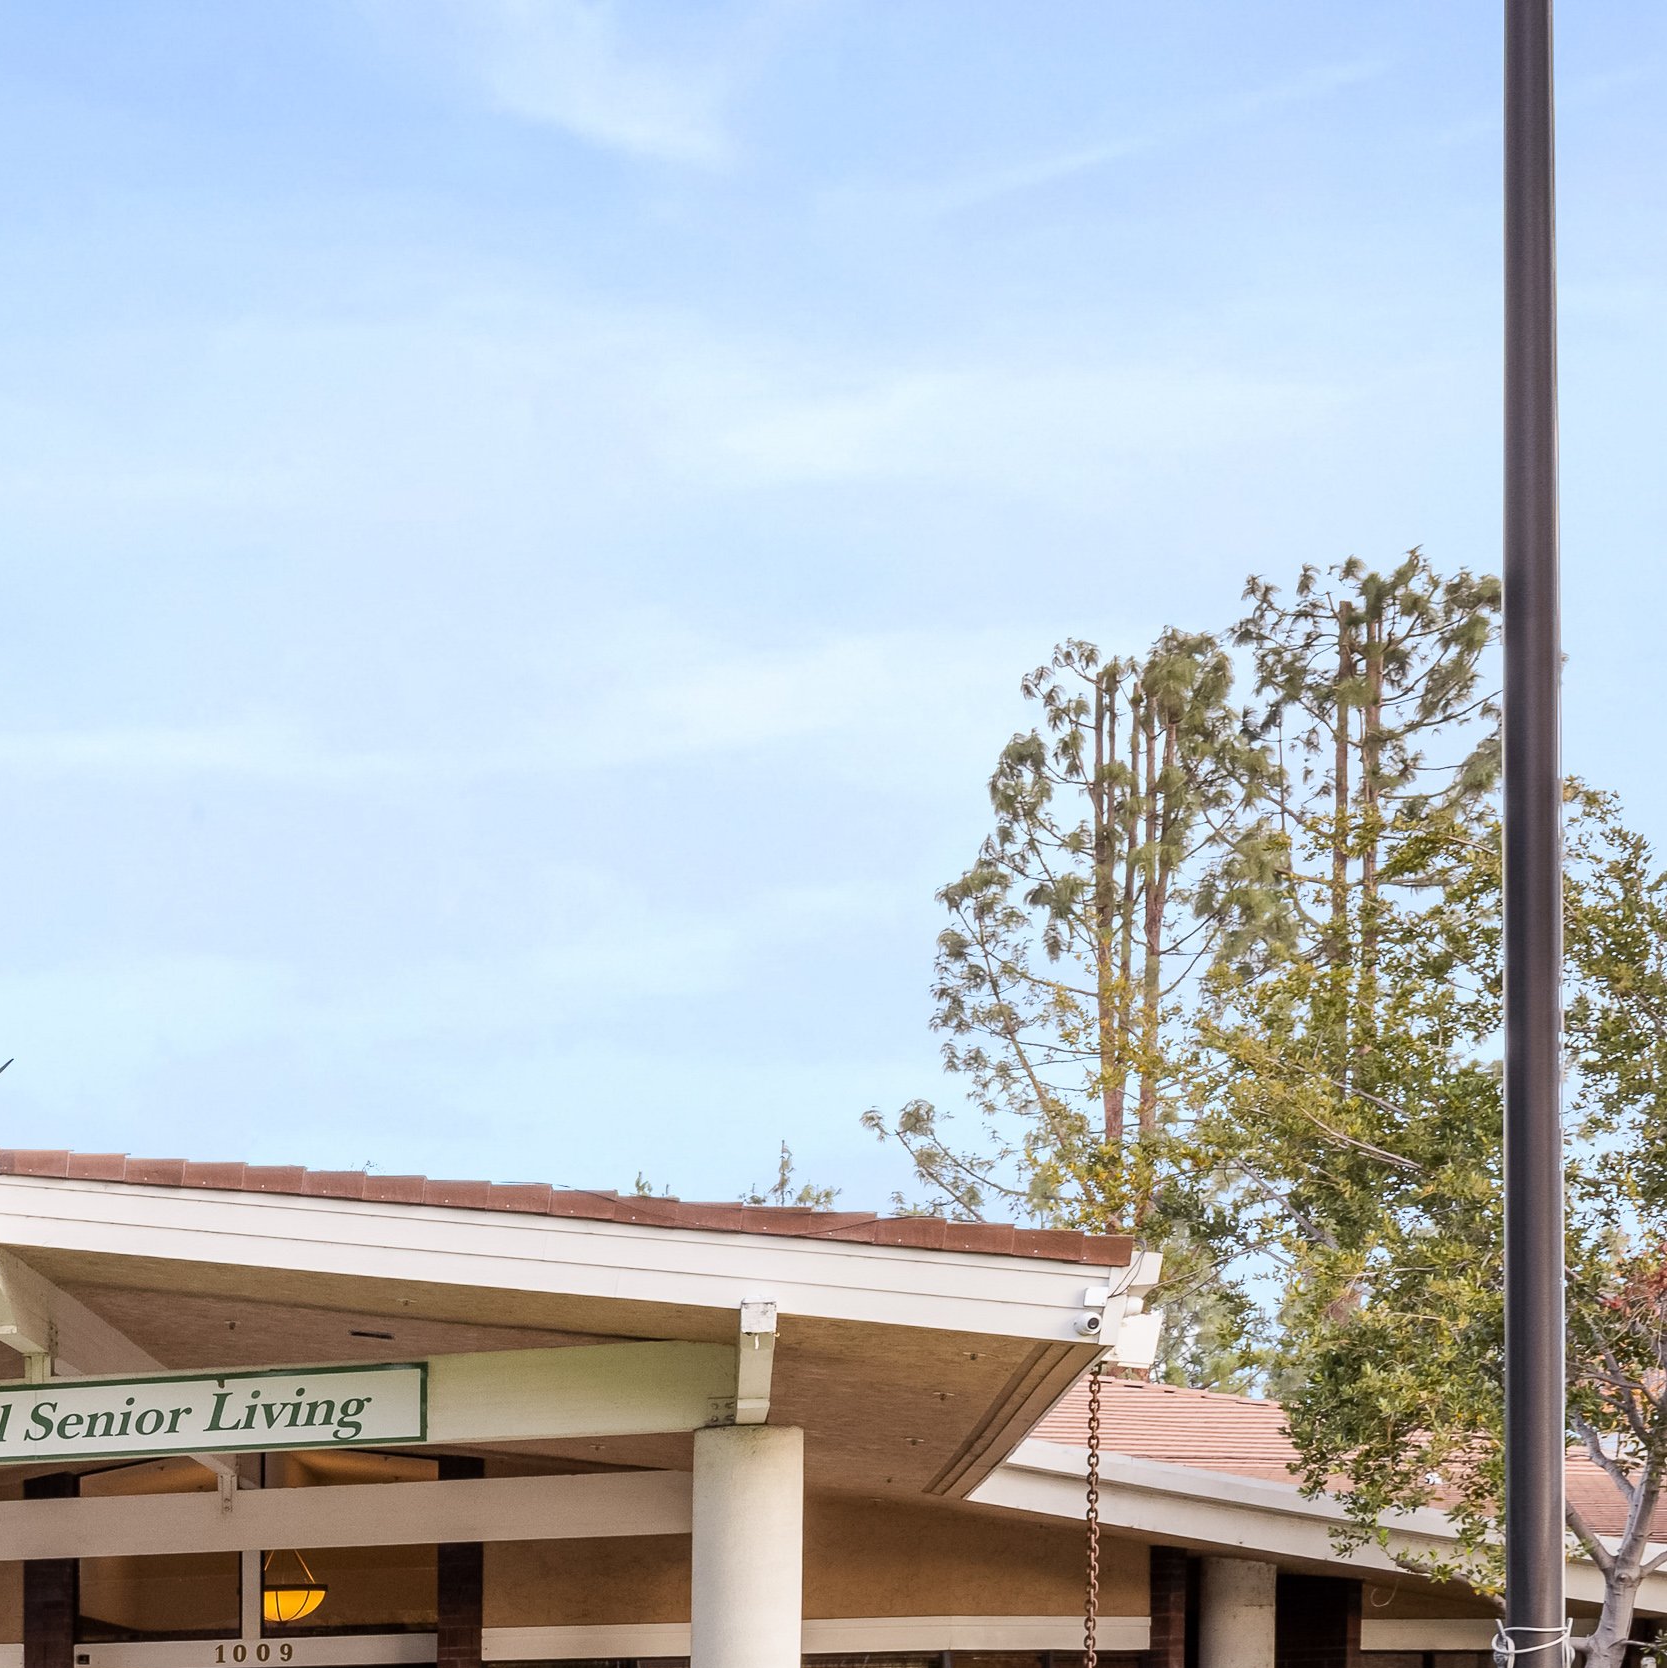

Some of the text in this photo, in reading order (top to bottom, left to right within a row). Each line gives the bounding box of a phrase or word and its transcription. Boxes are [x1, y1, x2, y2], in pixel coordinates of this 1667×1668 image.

[23, 1396, 193, 1442] Senior
[202, 1387, 373, 1440] Living
[214, 1643, 293, 1664] 1009
